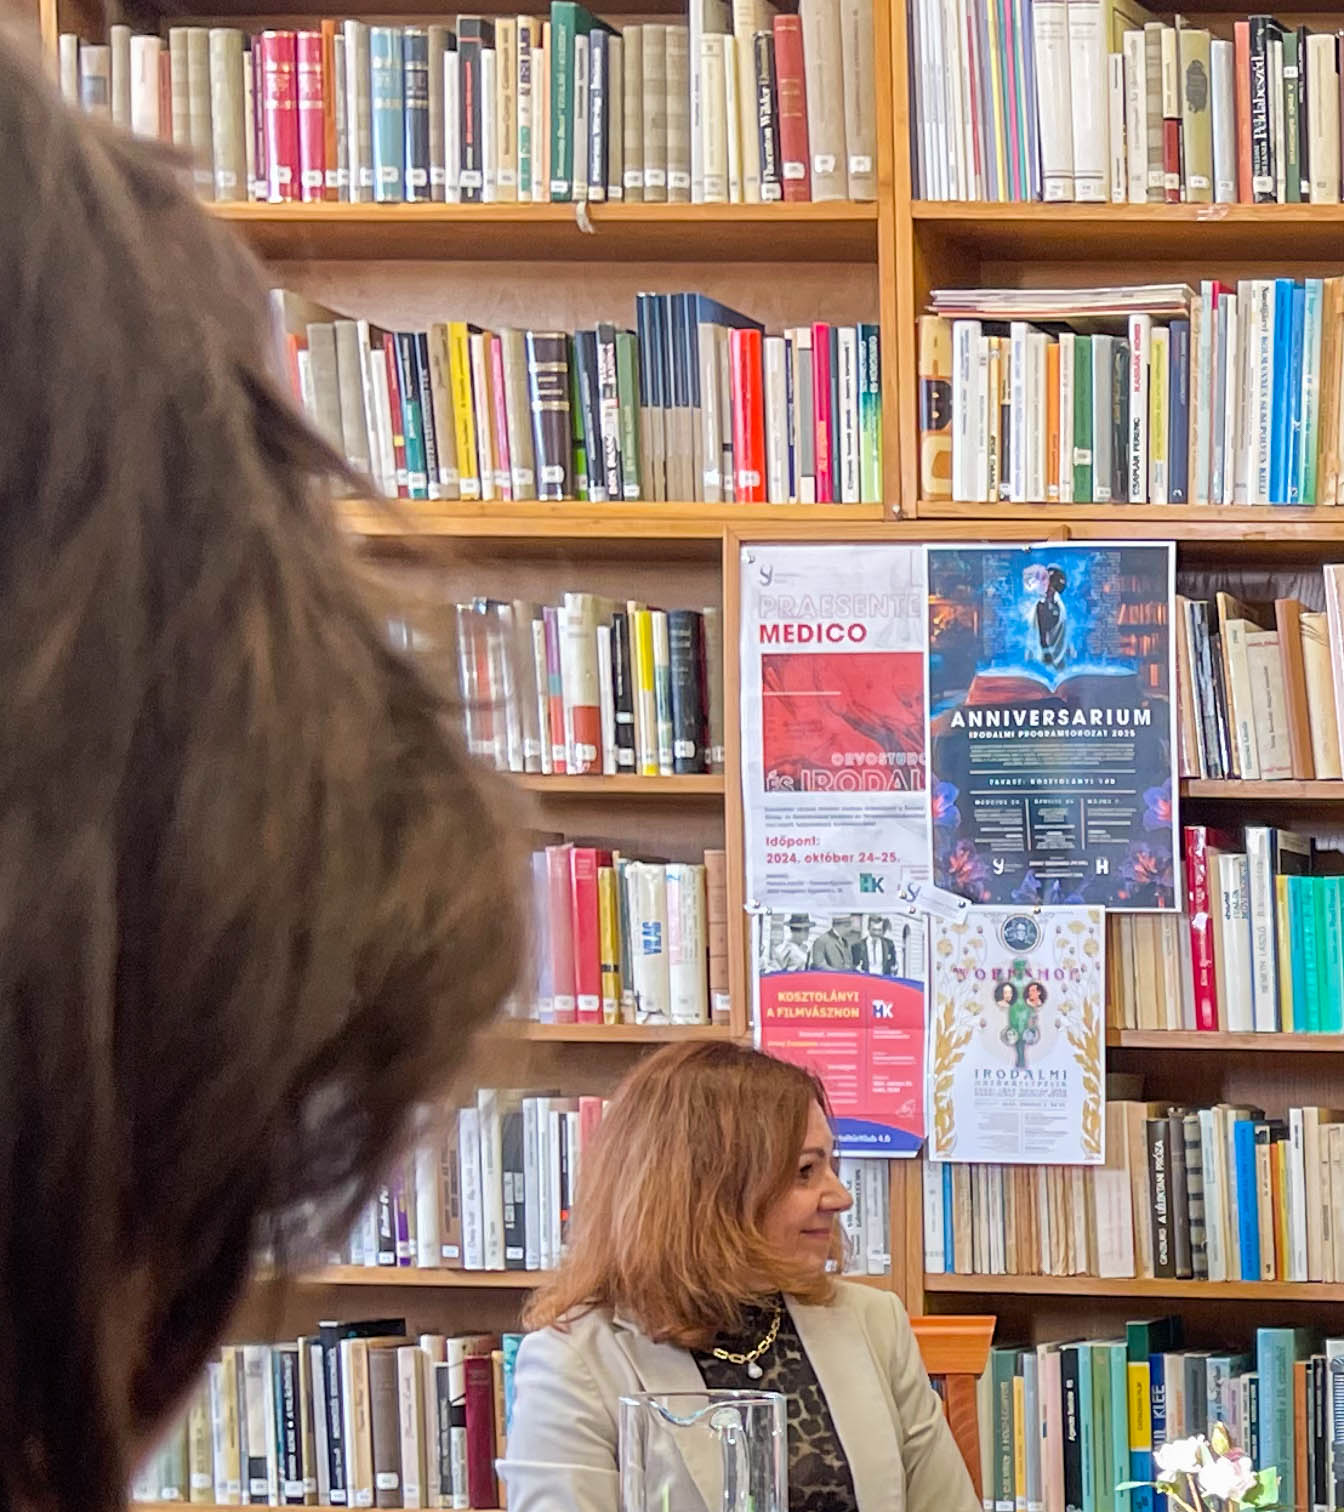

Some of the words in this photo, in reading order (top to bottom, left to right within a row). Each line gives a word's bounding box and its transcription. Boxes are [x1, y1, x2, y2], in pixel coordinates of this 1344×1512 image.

[759, 623, 867, 644] MEDICO
[951, 708, 1151, 728] ANNIVERSARIUM
[968, 730, 1015, 739] IRODALMI
[766, 836, 820, 849] Időpont:
[766, 853, 801, 865] 2024.
[804, 852, 854, 864] október
[778, 989, 859, 1003] KOSZTOLÁNYI
[766, 1007, 775, 1018] A
[777, 1005, 860, 1018] FILMVÁSZNON
[973, 1068, 1068, 1080] IRODALMI
[1154, 1139, 1165, 1170] PRÓZA
[1152, 1385, 1166, 1419] KLEE
